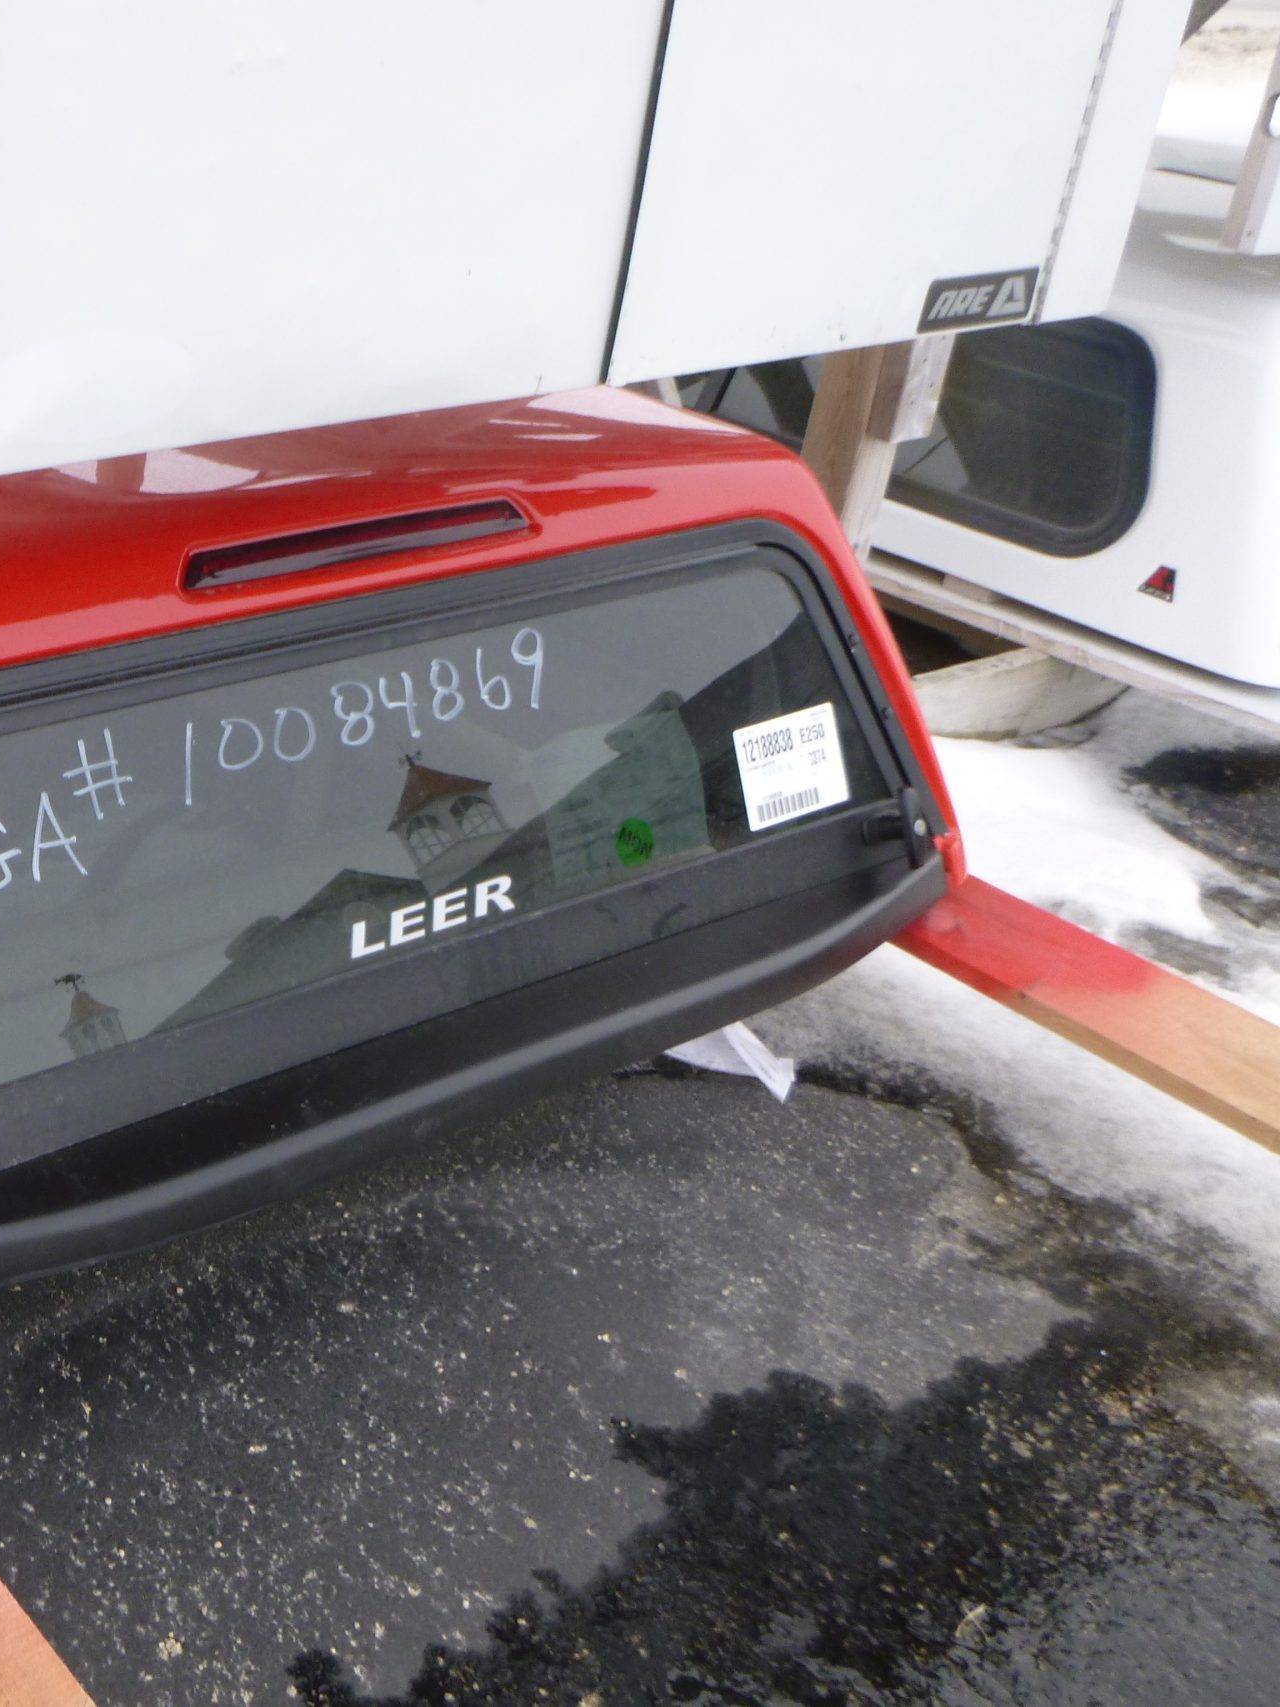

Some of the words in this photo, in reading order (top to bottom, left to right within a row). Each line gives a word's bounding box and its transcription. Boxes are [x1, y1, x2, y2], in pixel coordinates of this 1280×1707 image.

[927, 284, 995, 320] ARE
[185, 627, 544, 806] 10084869
[351, 875, 516, 960] LEER
